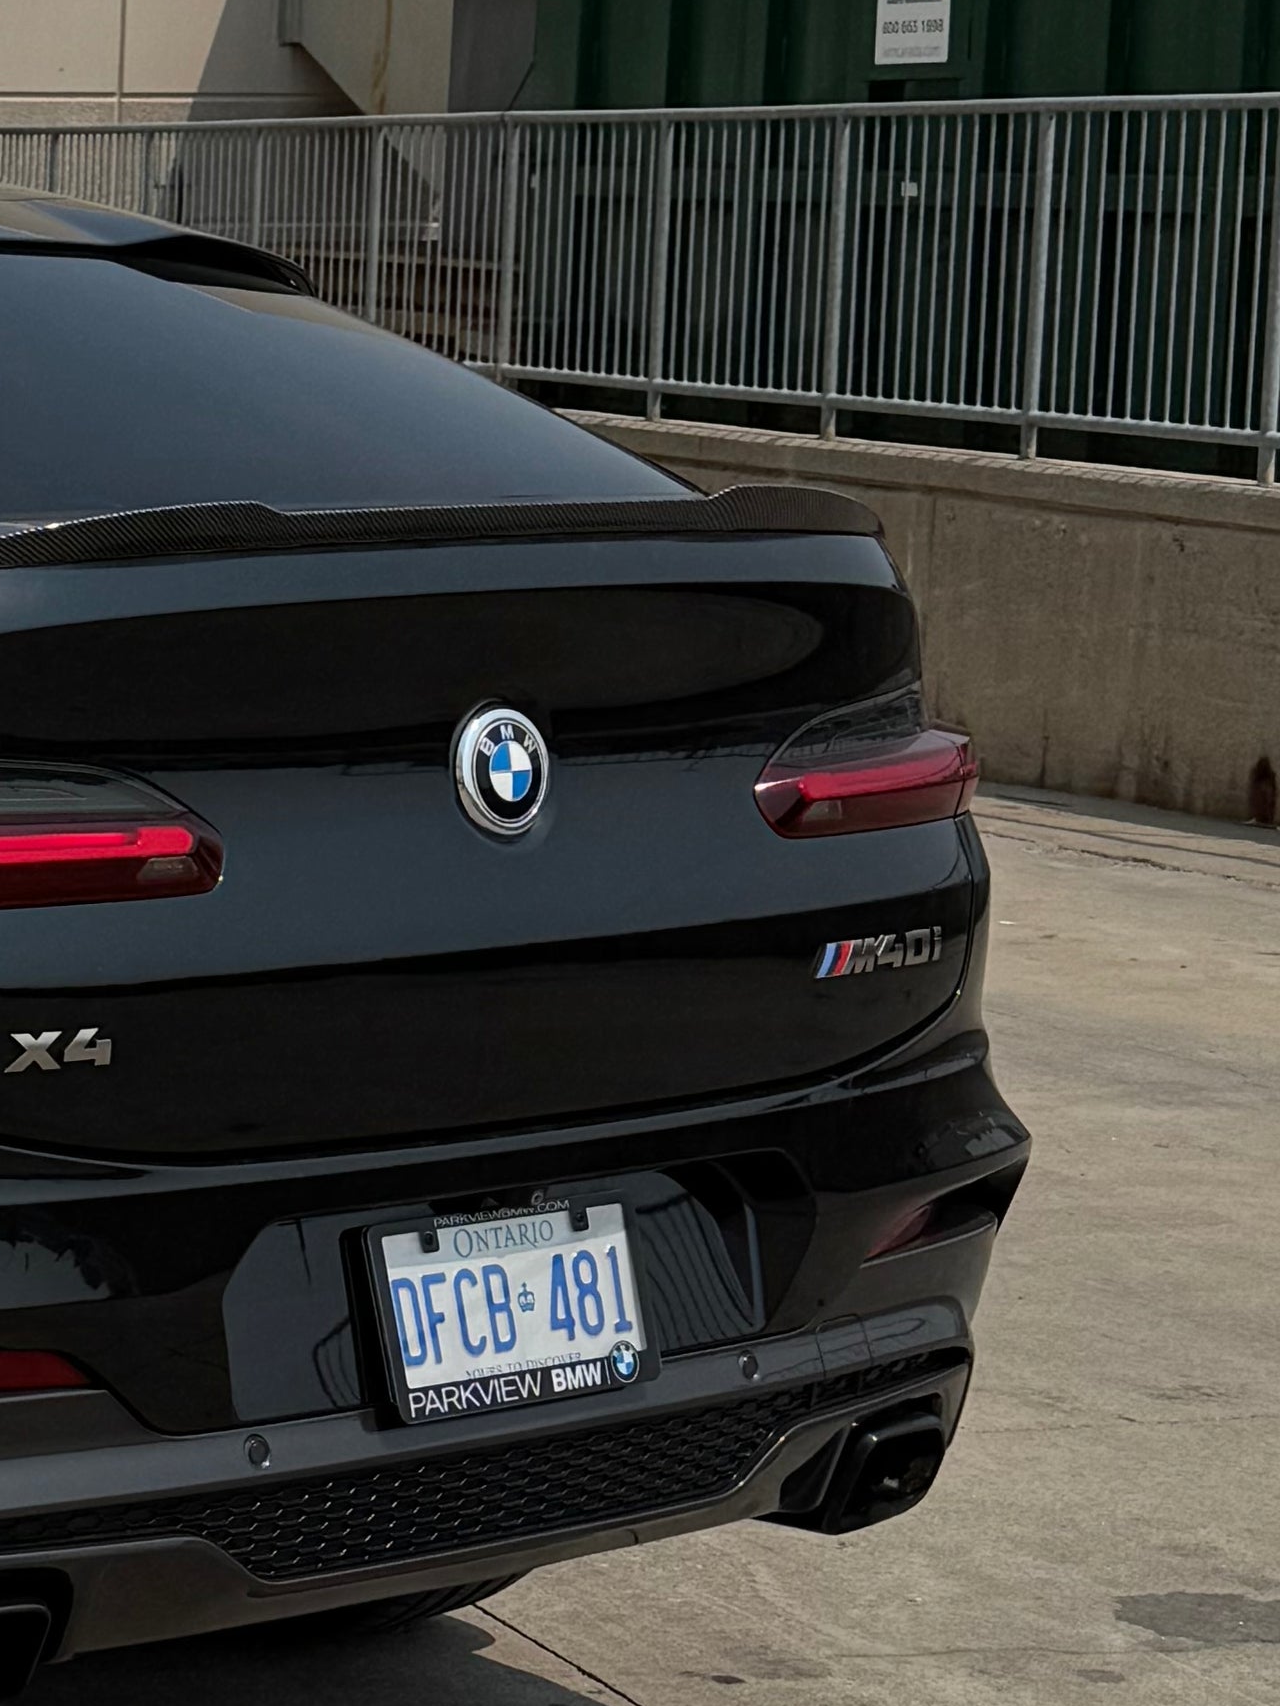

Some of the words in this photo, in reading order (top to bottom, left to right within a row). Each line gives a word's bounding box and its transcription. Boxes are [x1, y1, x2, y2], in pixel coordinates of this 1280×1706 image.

[479, 724, 538, 757] BMW
[838, 925, 942, 975] M40i
[3, 1027, 112, 1074] X4
[433, 1199, 570, 1228] PARKVIEWBMW.COM
[453, 1219, 554, 1258] ONTARIO
[390, 1263, 518, 1367] DFCB
[549, 1244, 634, 1342] 481
[408, 1371, 543, 1419] PARKVIEW
[551, 1360, 603, 1393] BMW
